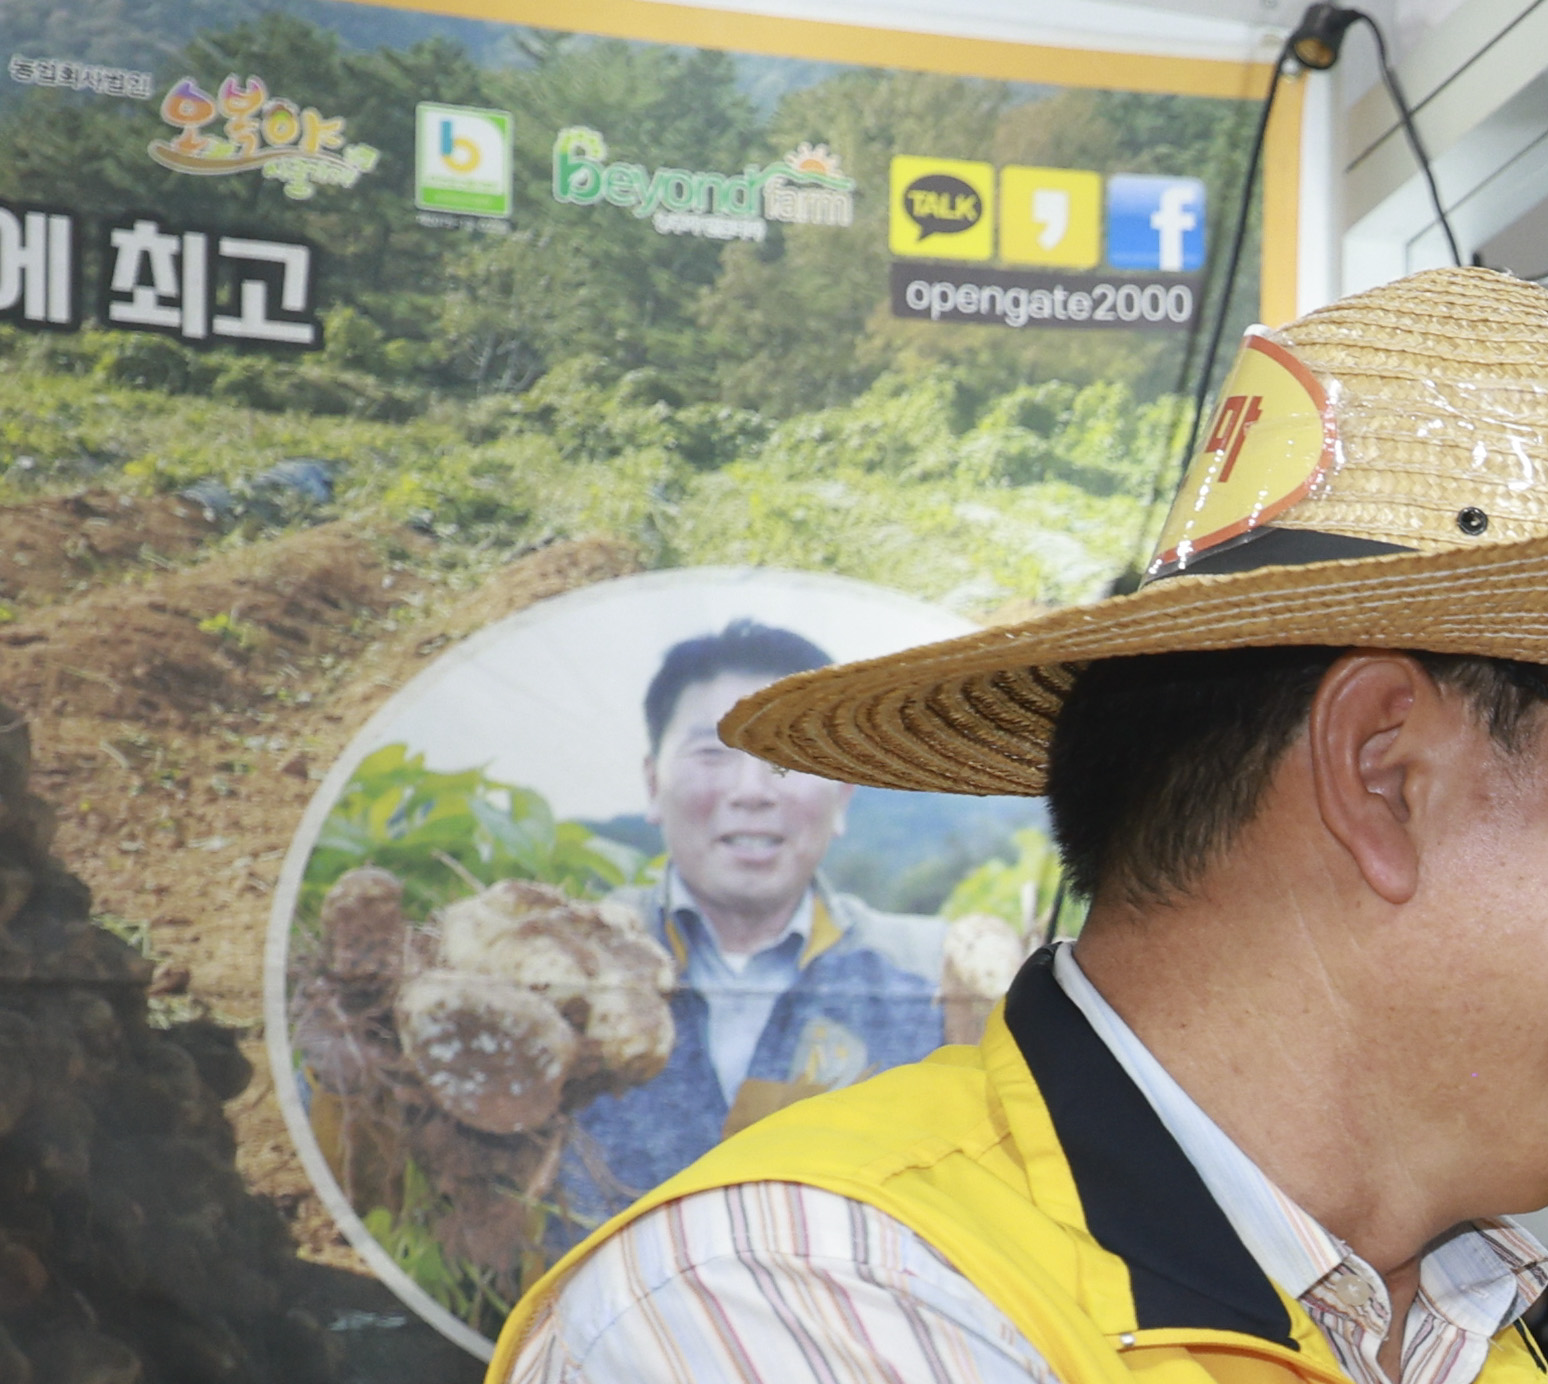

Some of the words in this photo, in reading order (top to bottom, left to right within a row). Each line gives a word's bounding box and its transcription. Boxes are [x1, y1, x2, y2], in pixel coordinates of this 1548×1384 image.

[907, 189, 981, 219] TALK
[109, 220, 315, 343] 최고
[905, 280, 1193, 327] opengate2000
